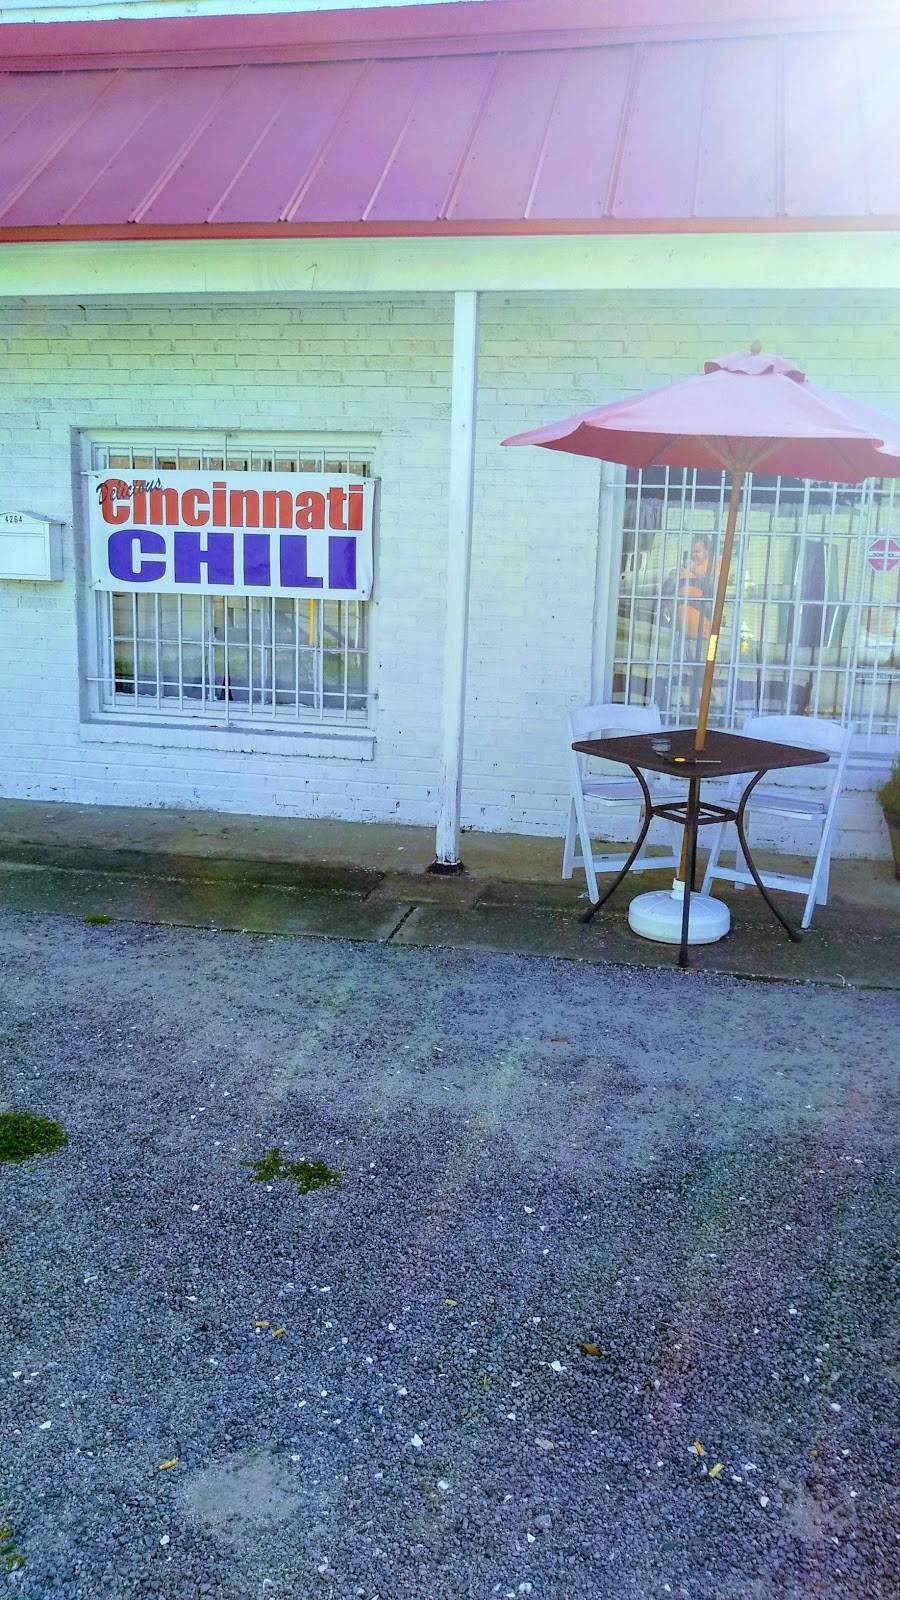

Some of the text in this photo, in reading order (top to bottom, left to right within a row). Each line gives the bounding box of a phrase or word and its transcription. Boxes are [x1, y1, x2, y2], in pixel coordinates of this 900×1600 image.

[96, 477, 162, 505] Delicious
[101, 478, 364, 531] Cincinnati
[108, 529, 357, 590] CHILI
